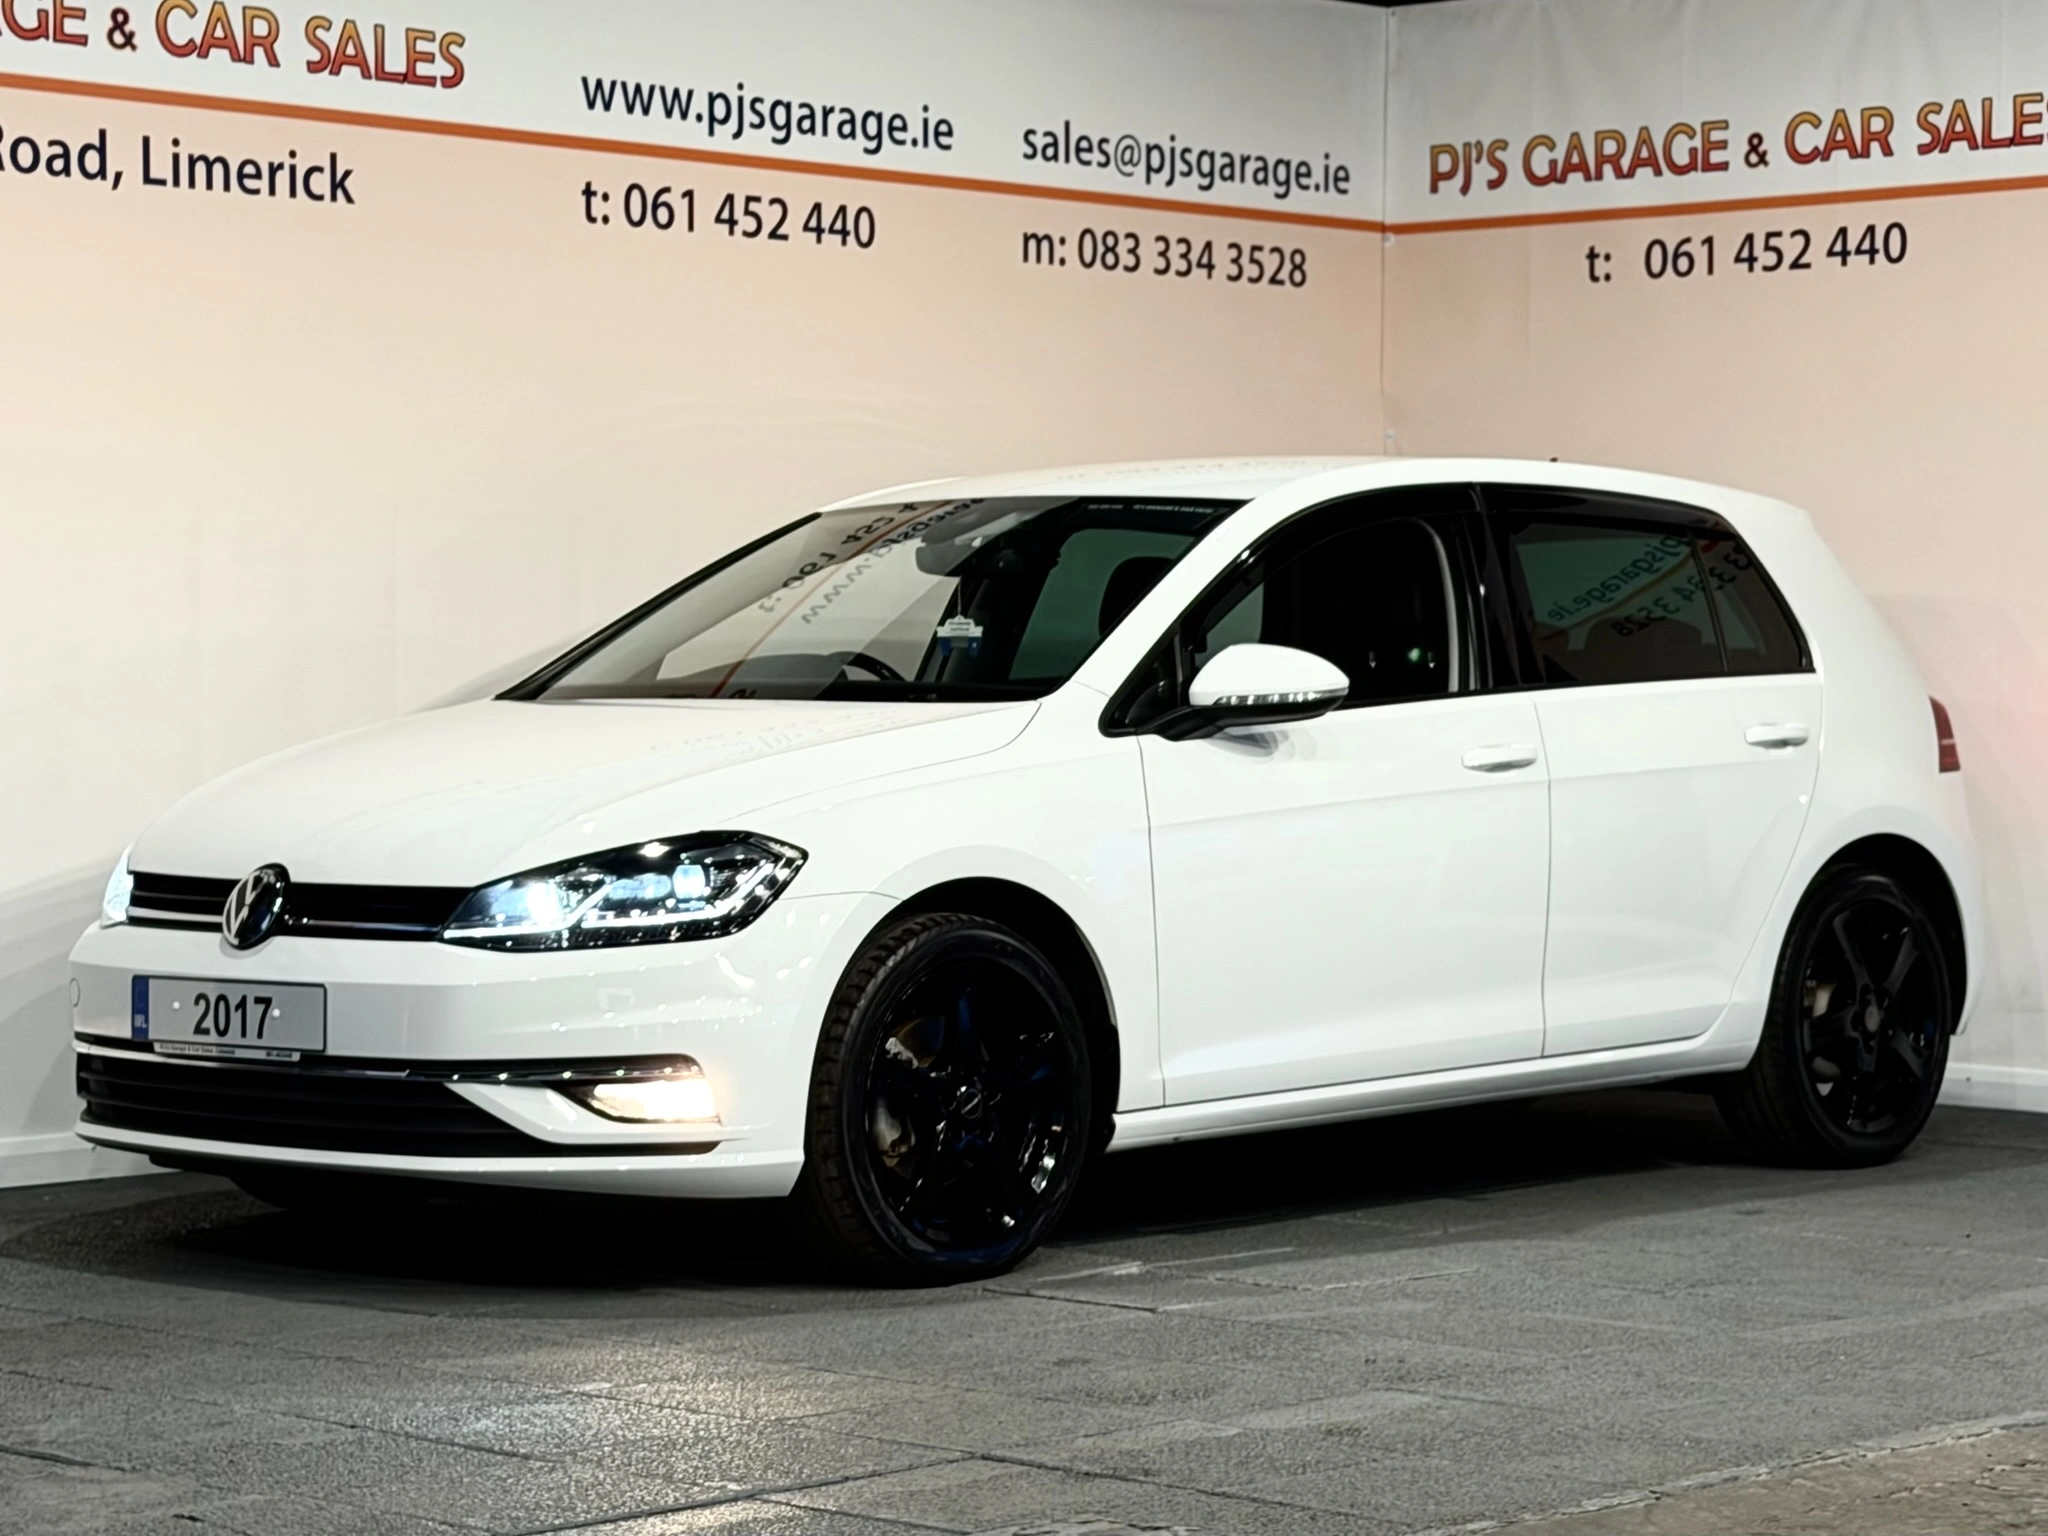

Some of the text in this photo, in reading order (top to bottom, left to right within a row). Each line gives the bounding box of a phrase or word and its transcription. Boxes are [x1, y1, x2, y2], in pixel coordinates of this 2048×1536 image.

[0, 0, 466, 89] GE & CAR SALES
[582, 77, 954, 155] www.pjsgarage.ie
[1429, 92, 2048, 197] PJ'S GARAGE & CAR SALE
[0, 126, 355, 205] oad, Limerick
[1022, 120, 1351, 199] sales@pjsgarage.ie
[582, 181, 876, 249] t: 061 452 440
[1585, 222, 1908, 284] t: 061 452 440
[1023, 228, 1308, 289] m: 083 334 3528
[193, 993, 273, 1040] 2017
